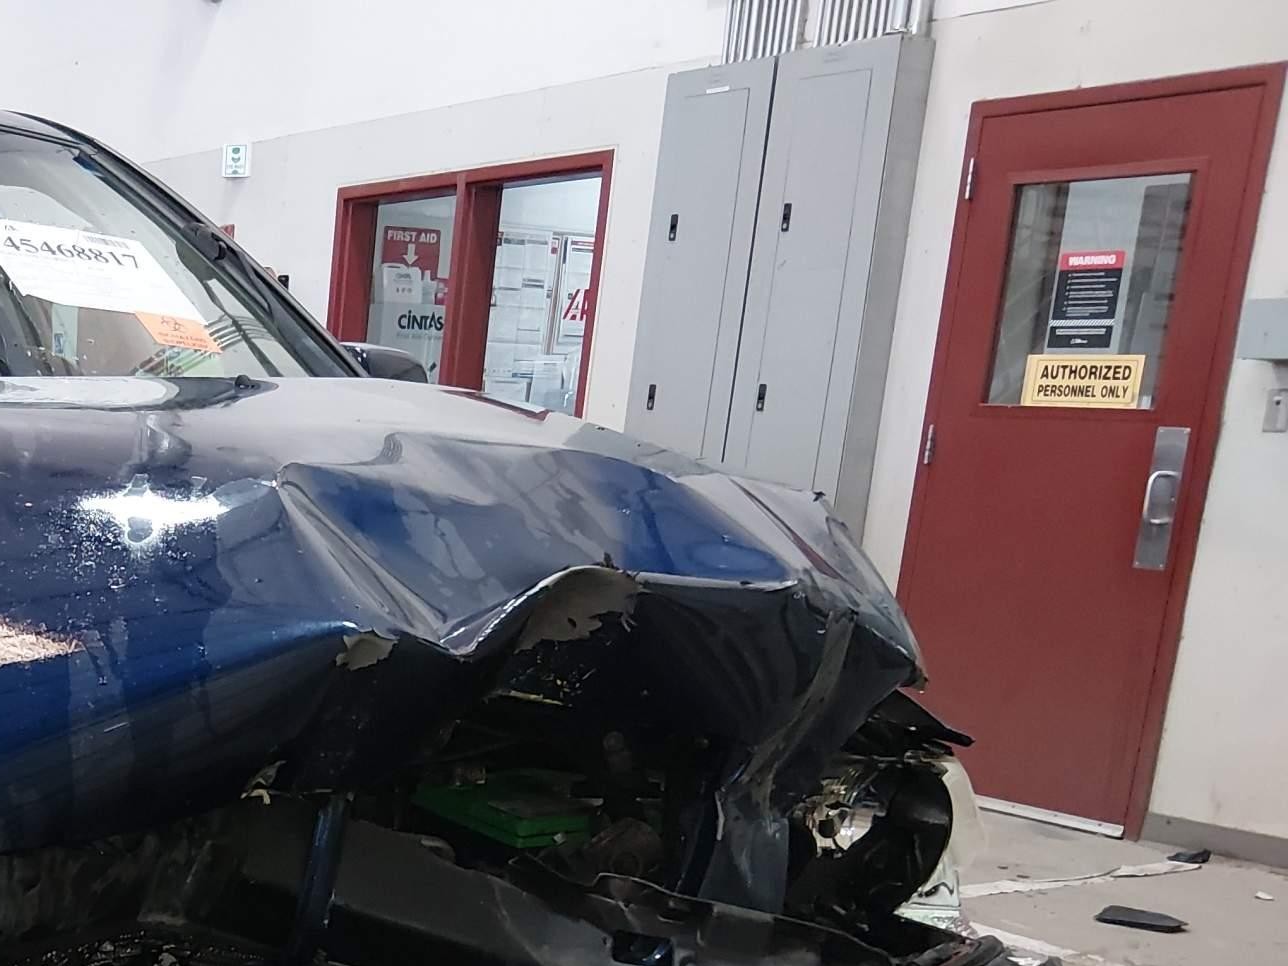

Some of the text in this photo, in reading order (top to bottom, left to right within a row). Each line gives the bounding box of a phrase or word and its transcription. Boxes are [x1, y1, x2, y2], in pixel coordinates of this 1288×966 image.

[387, 230, 437, 243] FIRST AID
[3, 236, 139, 269] 45468817
[1068, 254, 1117, 266] WARNING
[1040, 365, 1132, 380] AUTHORIZED
[1037, 384, 1129, 398] PERSONNEL ONLY
